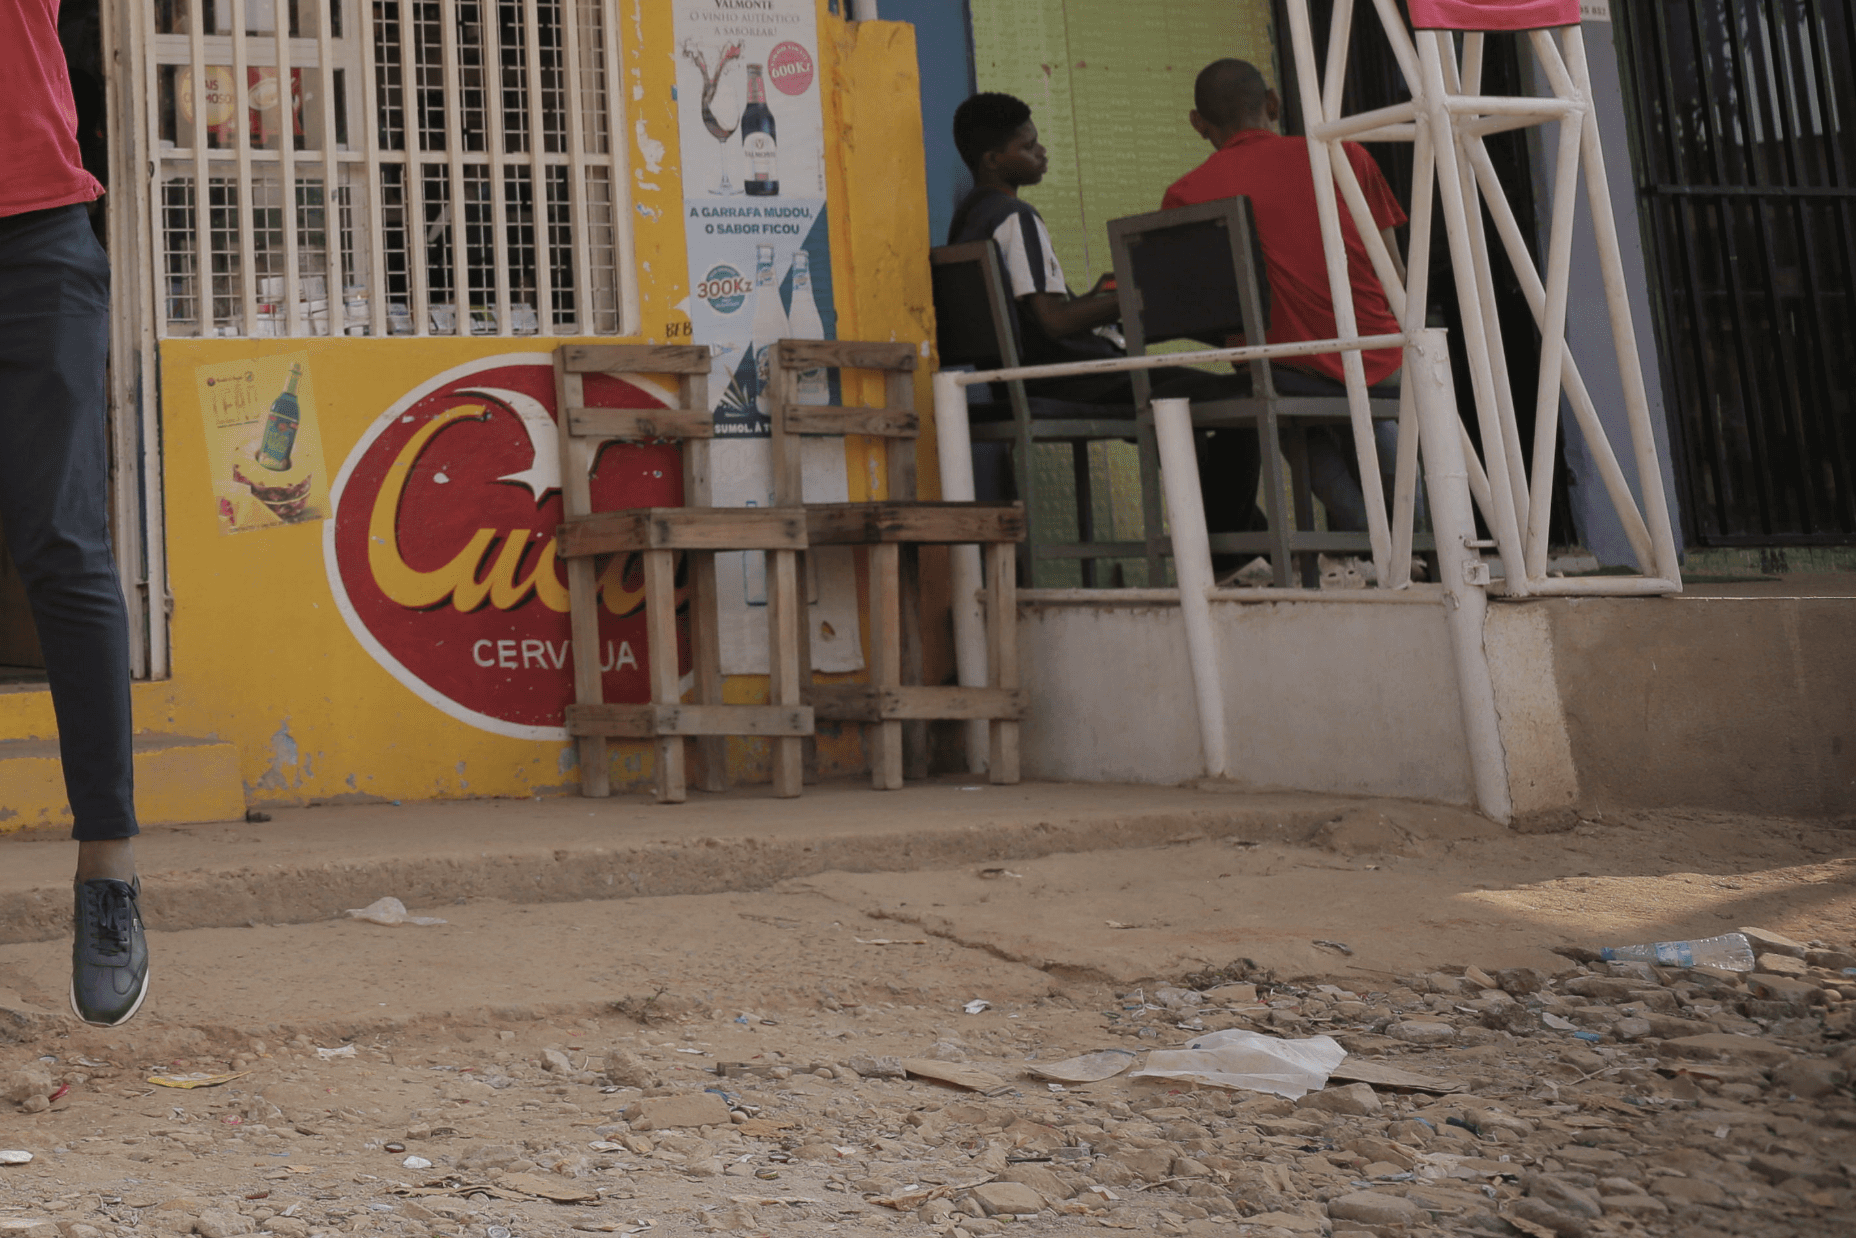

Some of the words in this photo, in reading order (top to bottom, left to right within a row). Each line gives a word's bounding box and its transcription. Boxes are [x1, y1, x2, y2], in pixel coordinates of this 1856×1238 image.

[689, 11, 700, 22] O
[702, 12, 739, 22] VINHO
[689, 207, 700, 218] A
[701, 207, 762, 218] GARRAFA
[763, 207, 813, 220] MUDOU,
[704, 223, 715, 235] O
[717, 223, 760, 235] SABOR
[762, 223, 801, 235] FICOU
[696, 276, 754, 299] 300Kz
[471, 638, 639, 672] CERVJA
